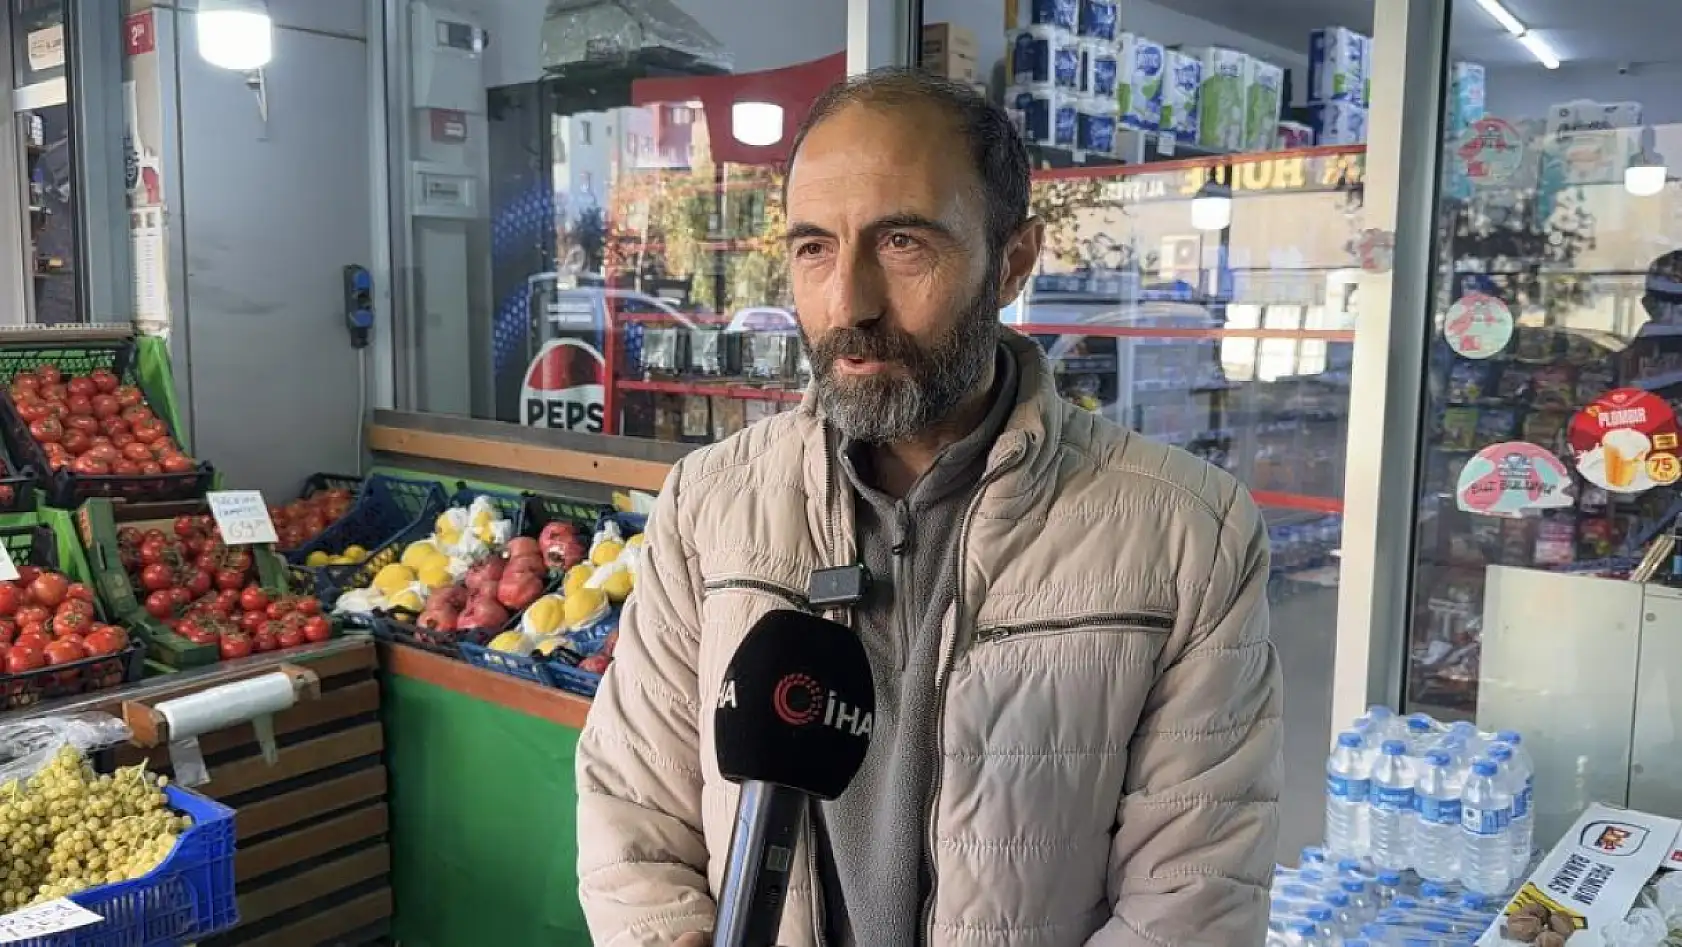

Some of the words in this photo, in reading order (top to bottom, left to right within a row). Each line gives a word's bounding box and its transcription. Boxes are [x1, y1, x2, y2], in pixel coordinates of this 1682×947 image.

[527, 398, 605, 434] PEPS
[1652, 457, 1673, 474] 75
[824, 690, 873, 737] İHA
